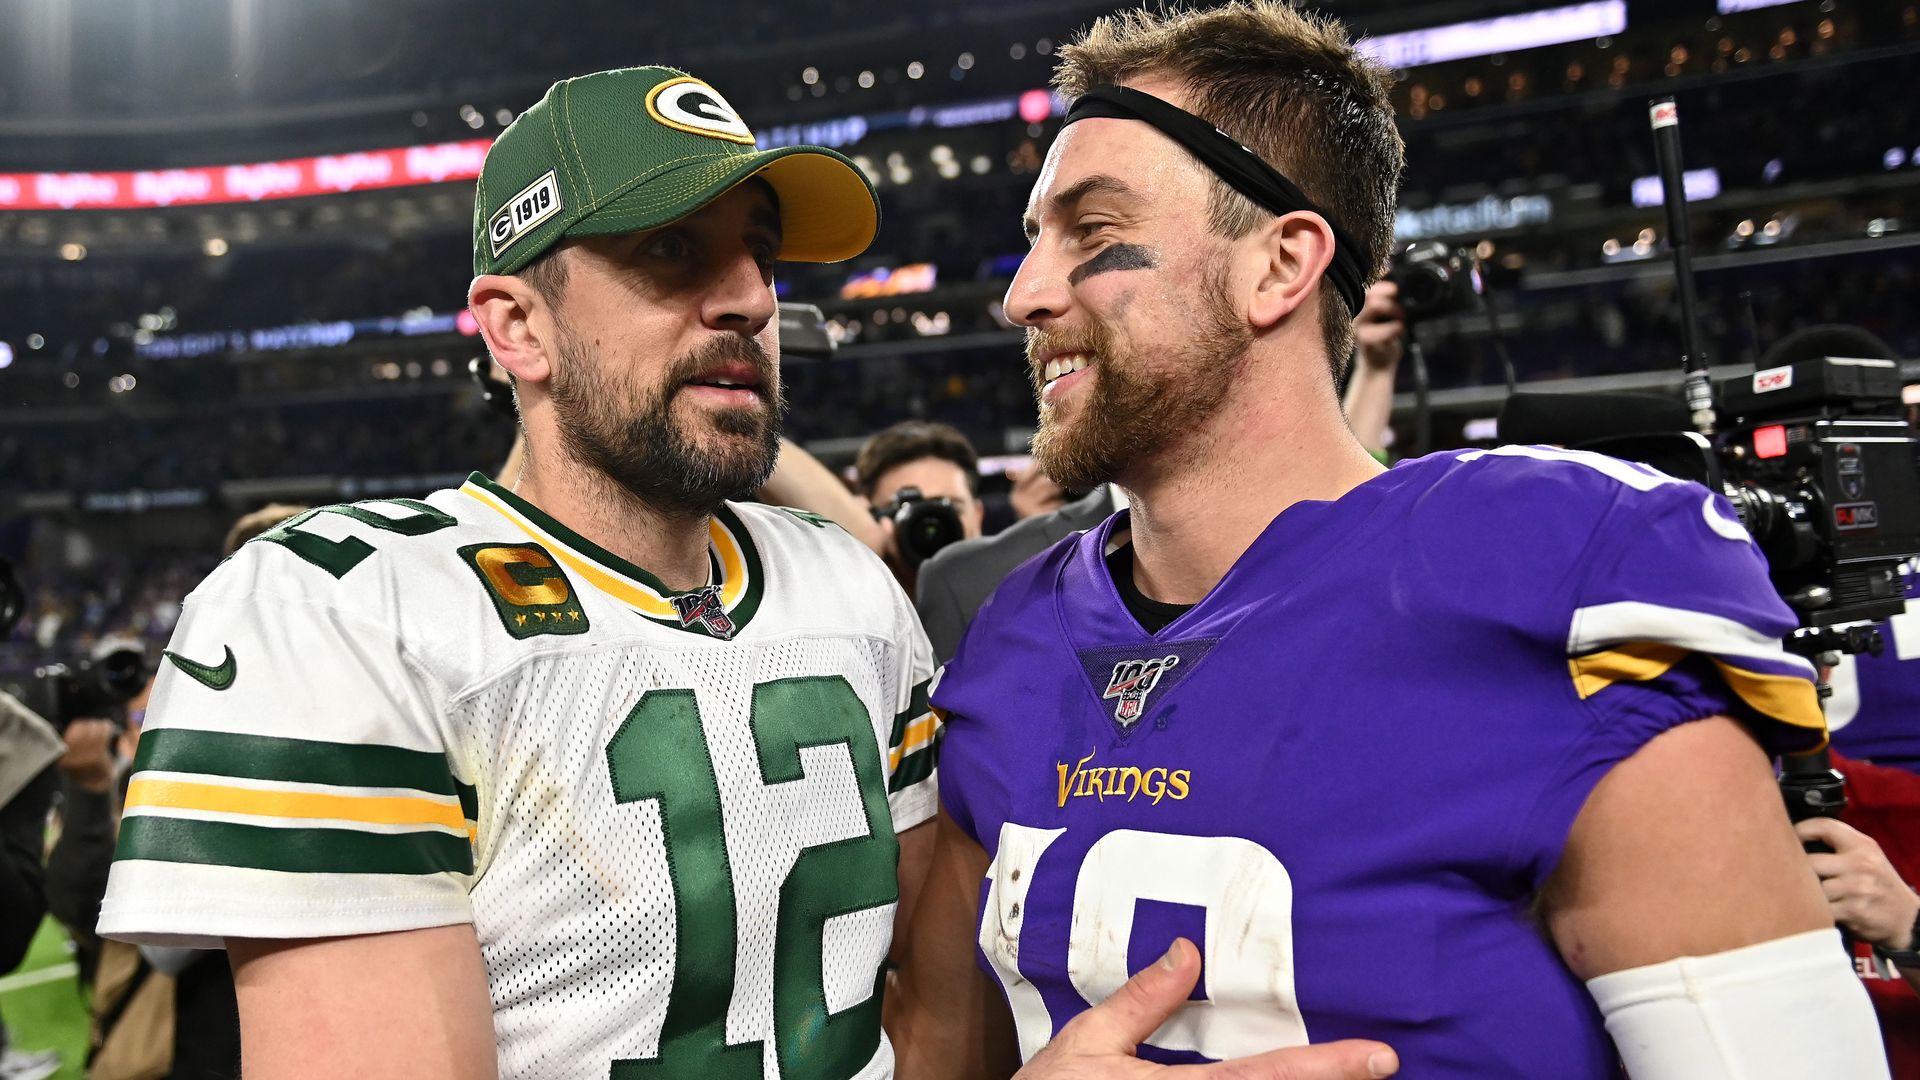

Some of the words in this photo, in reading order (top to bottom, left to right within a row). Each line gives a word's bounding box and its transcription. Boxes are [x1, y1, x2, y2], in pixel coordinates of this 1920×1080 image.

[651, 79, 754, 141] G
[514, 185, 551, 226] 1919
[475, 547, 569, 606] C
[605, 674, 899, 1080] 12
